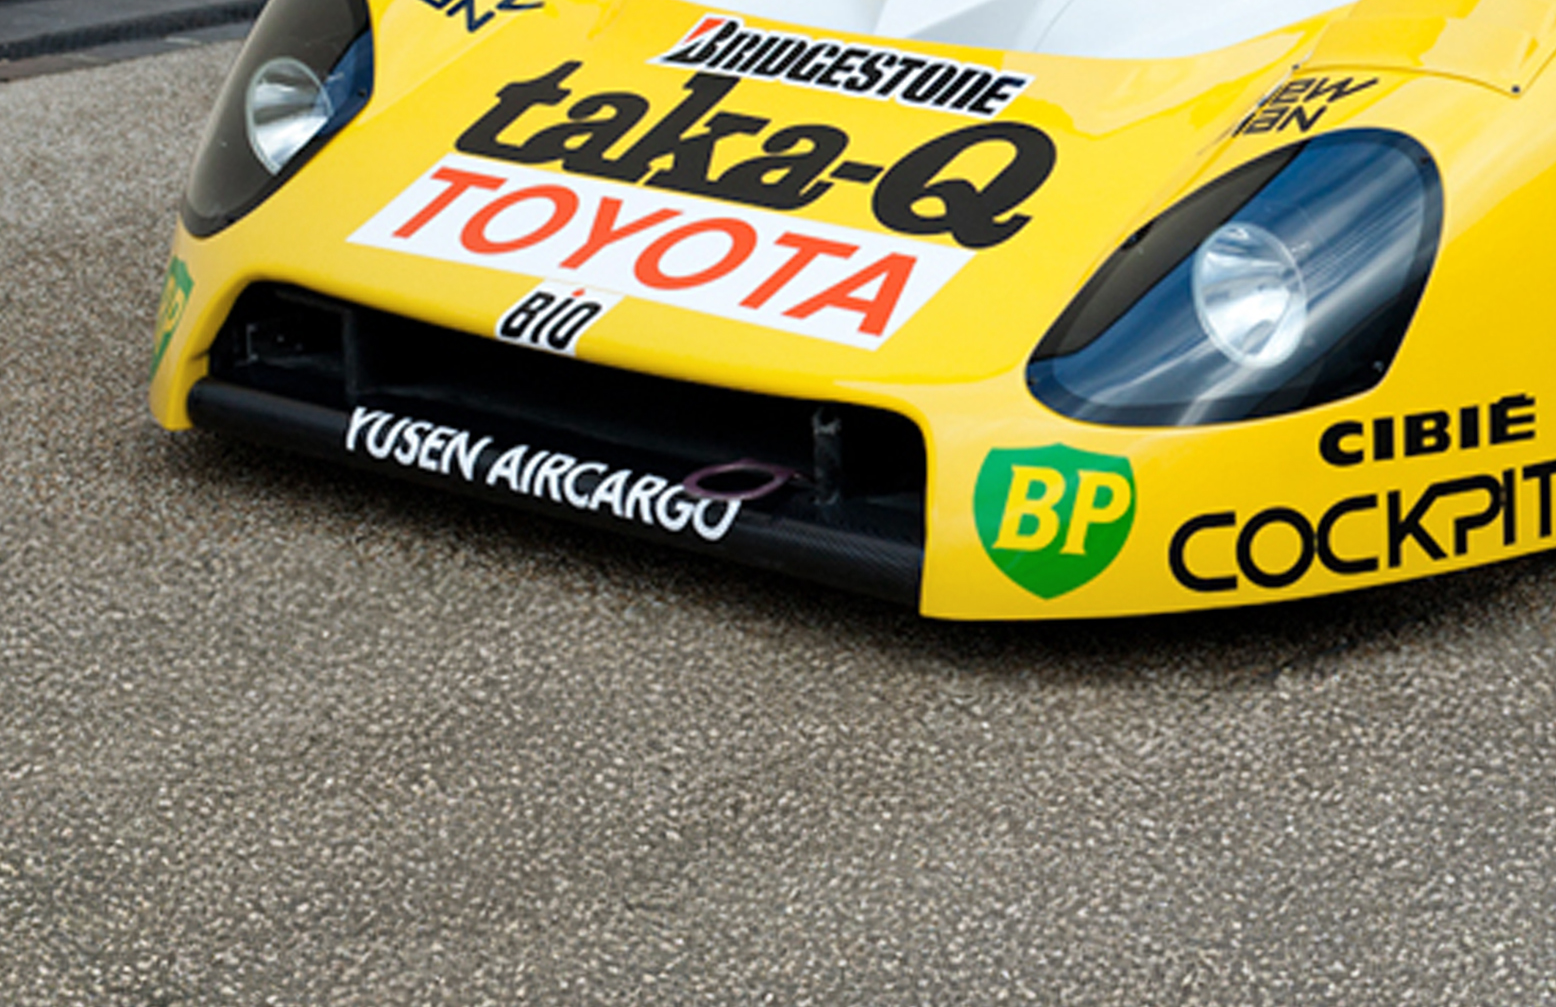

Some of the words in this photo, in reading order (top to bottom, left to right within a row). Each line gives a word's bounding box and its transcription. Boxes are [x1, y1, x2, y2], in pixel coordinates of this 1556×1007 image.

[662, 18, 1027, 115] BRIDGESTONE
[455, 59, 1057, 250] taka-Q
[392, 166, 920, 338] TOYOTA
[345, 406, 494, 481] YUSEN
[485, 443, 744, 542] AIRCARGO
[1319, 393, 1537, 468] CIBIÉ
[991, 463, 1133, 556] BP
